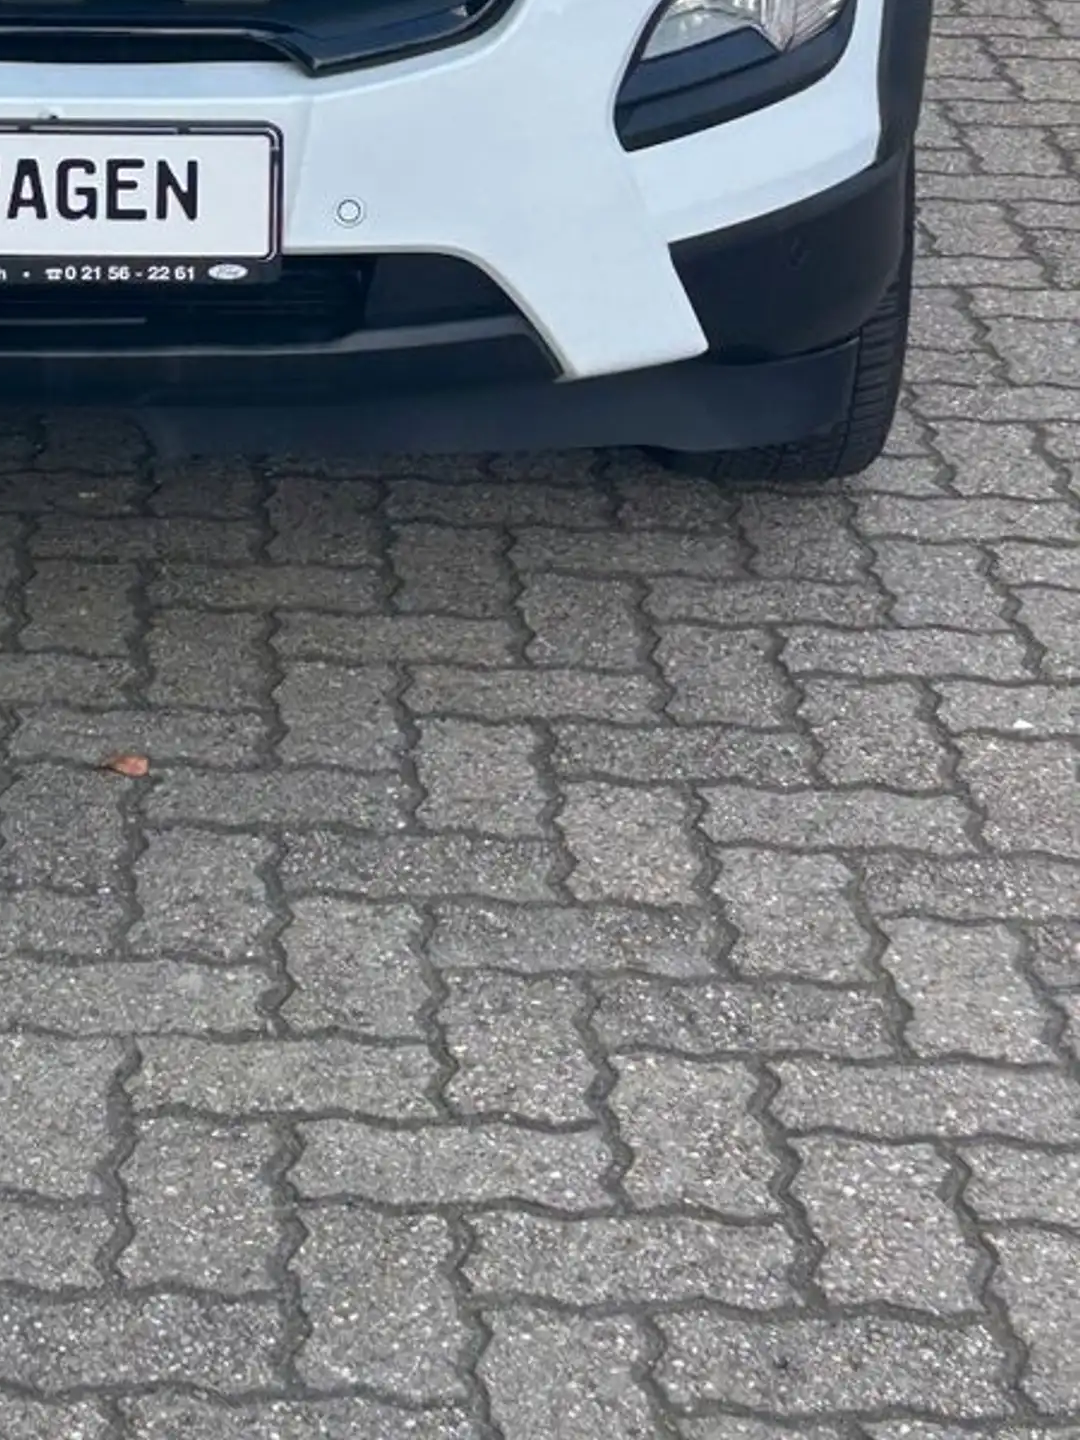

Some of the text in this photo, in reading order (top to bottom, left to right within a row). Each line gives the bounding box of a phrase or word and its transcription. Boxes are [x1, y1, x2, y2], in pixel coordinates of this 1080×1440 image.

[80, 265, 102, 281] 21
[146, 265, 171, 281] 22
[173, 265, 195, 281] 61
